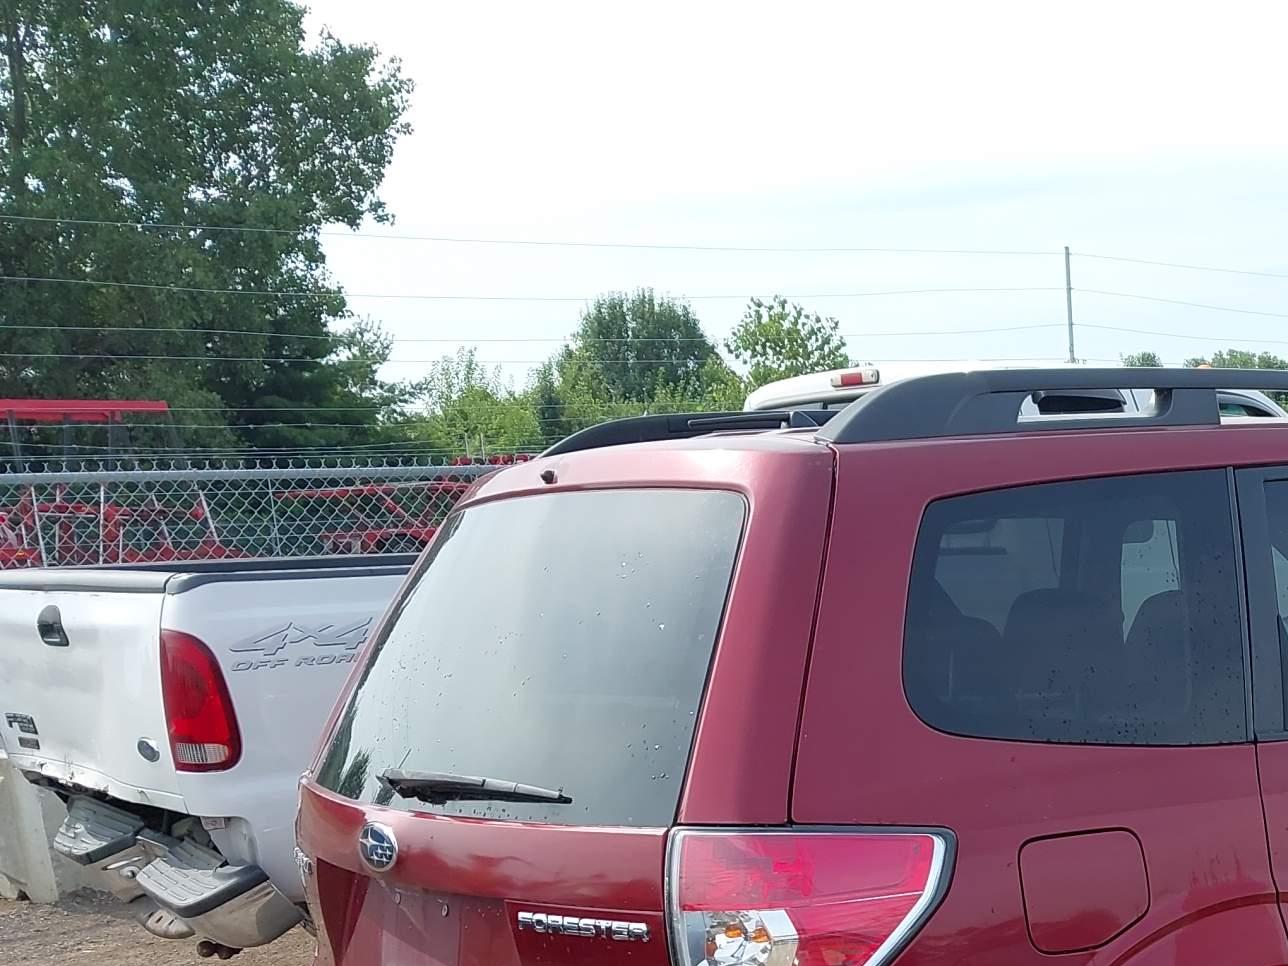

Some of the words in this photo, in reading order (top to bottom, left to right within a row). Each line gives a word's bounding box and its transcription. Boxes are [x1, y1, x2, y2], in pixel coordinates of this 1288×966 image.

[232, 658, 289, 672] OFF
[296, 654, 357, 668] ROA
[518, 911, 651, 942] FORESTER
